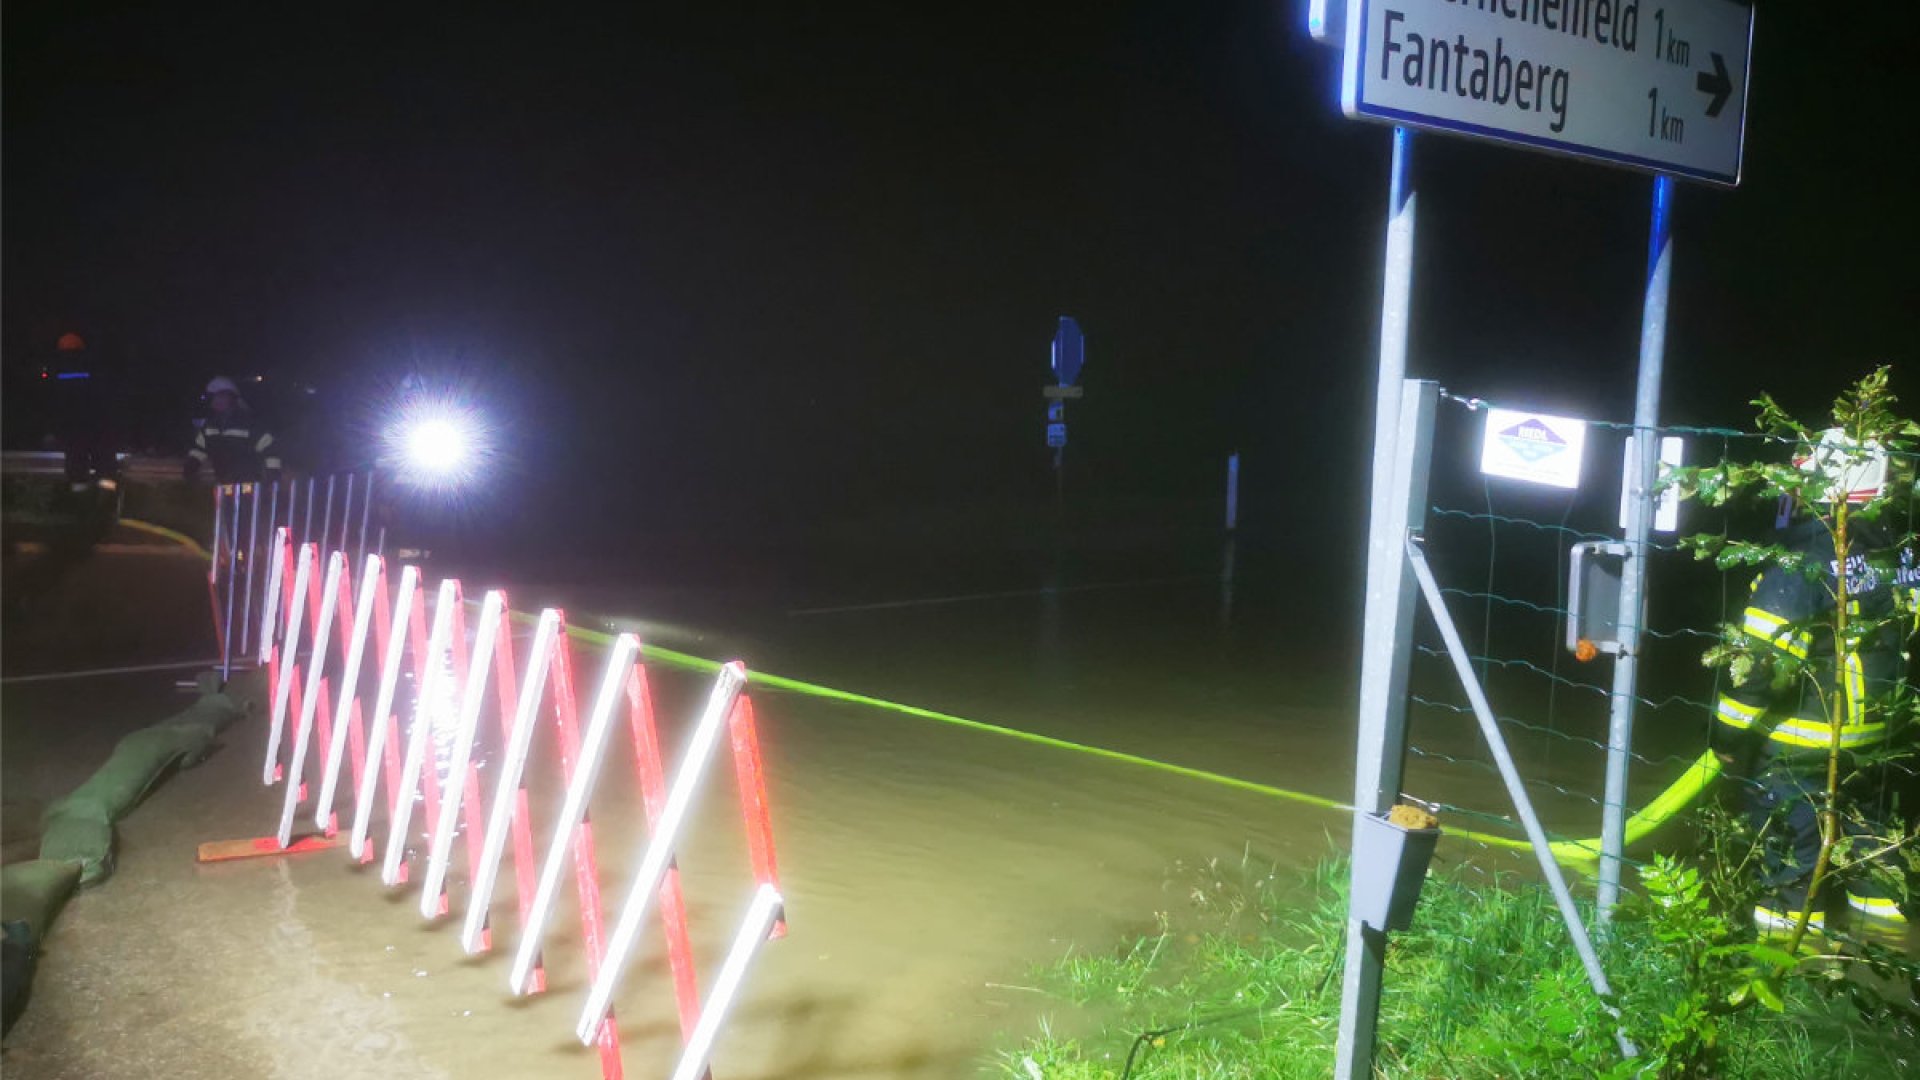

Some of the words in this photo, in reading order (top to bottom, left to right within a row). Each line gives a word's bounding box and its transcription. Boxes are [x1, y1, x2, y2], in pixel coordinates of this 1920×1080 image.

[1381, 9, 1569, 133] Fantaberg
[1648, 87, 1658, 137] 1
[1660, 106, 1684, 144] km
[1654, 7, 1665, 60] 1
[1666, 27, 1690, 68] km
